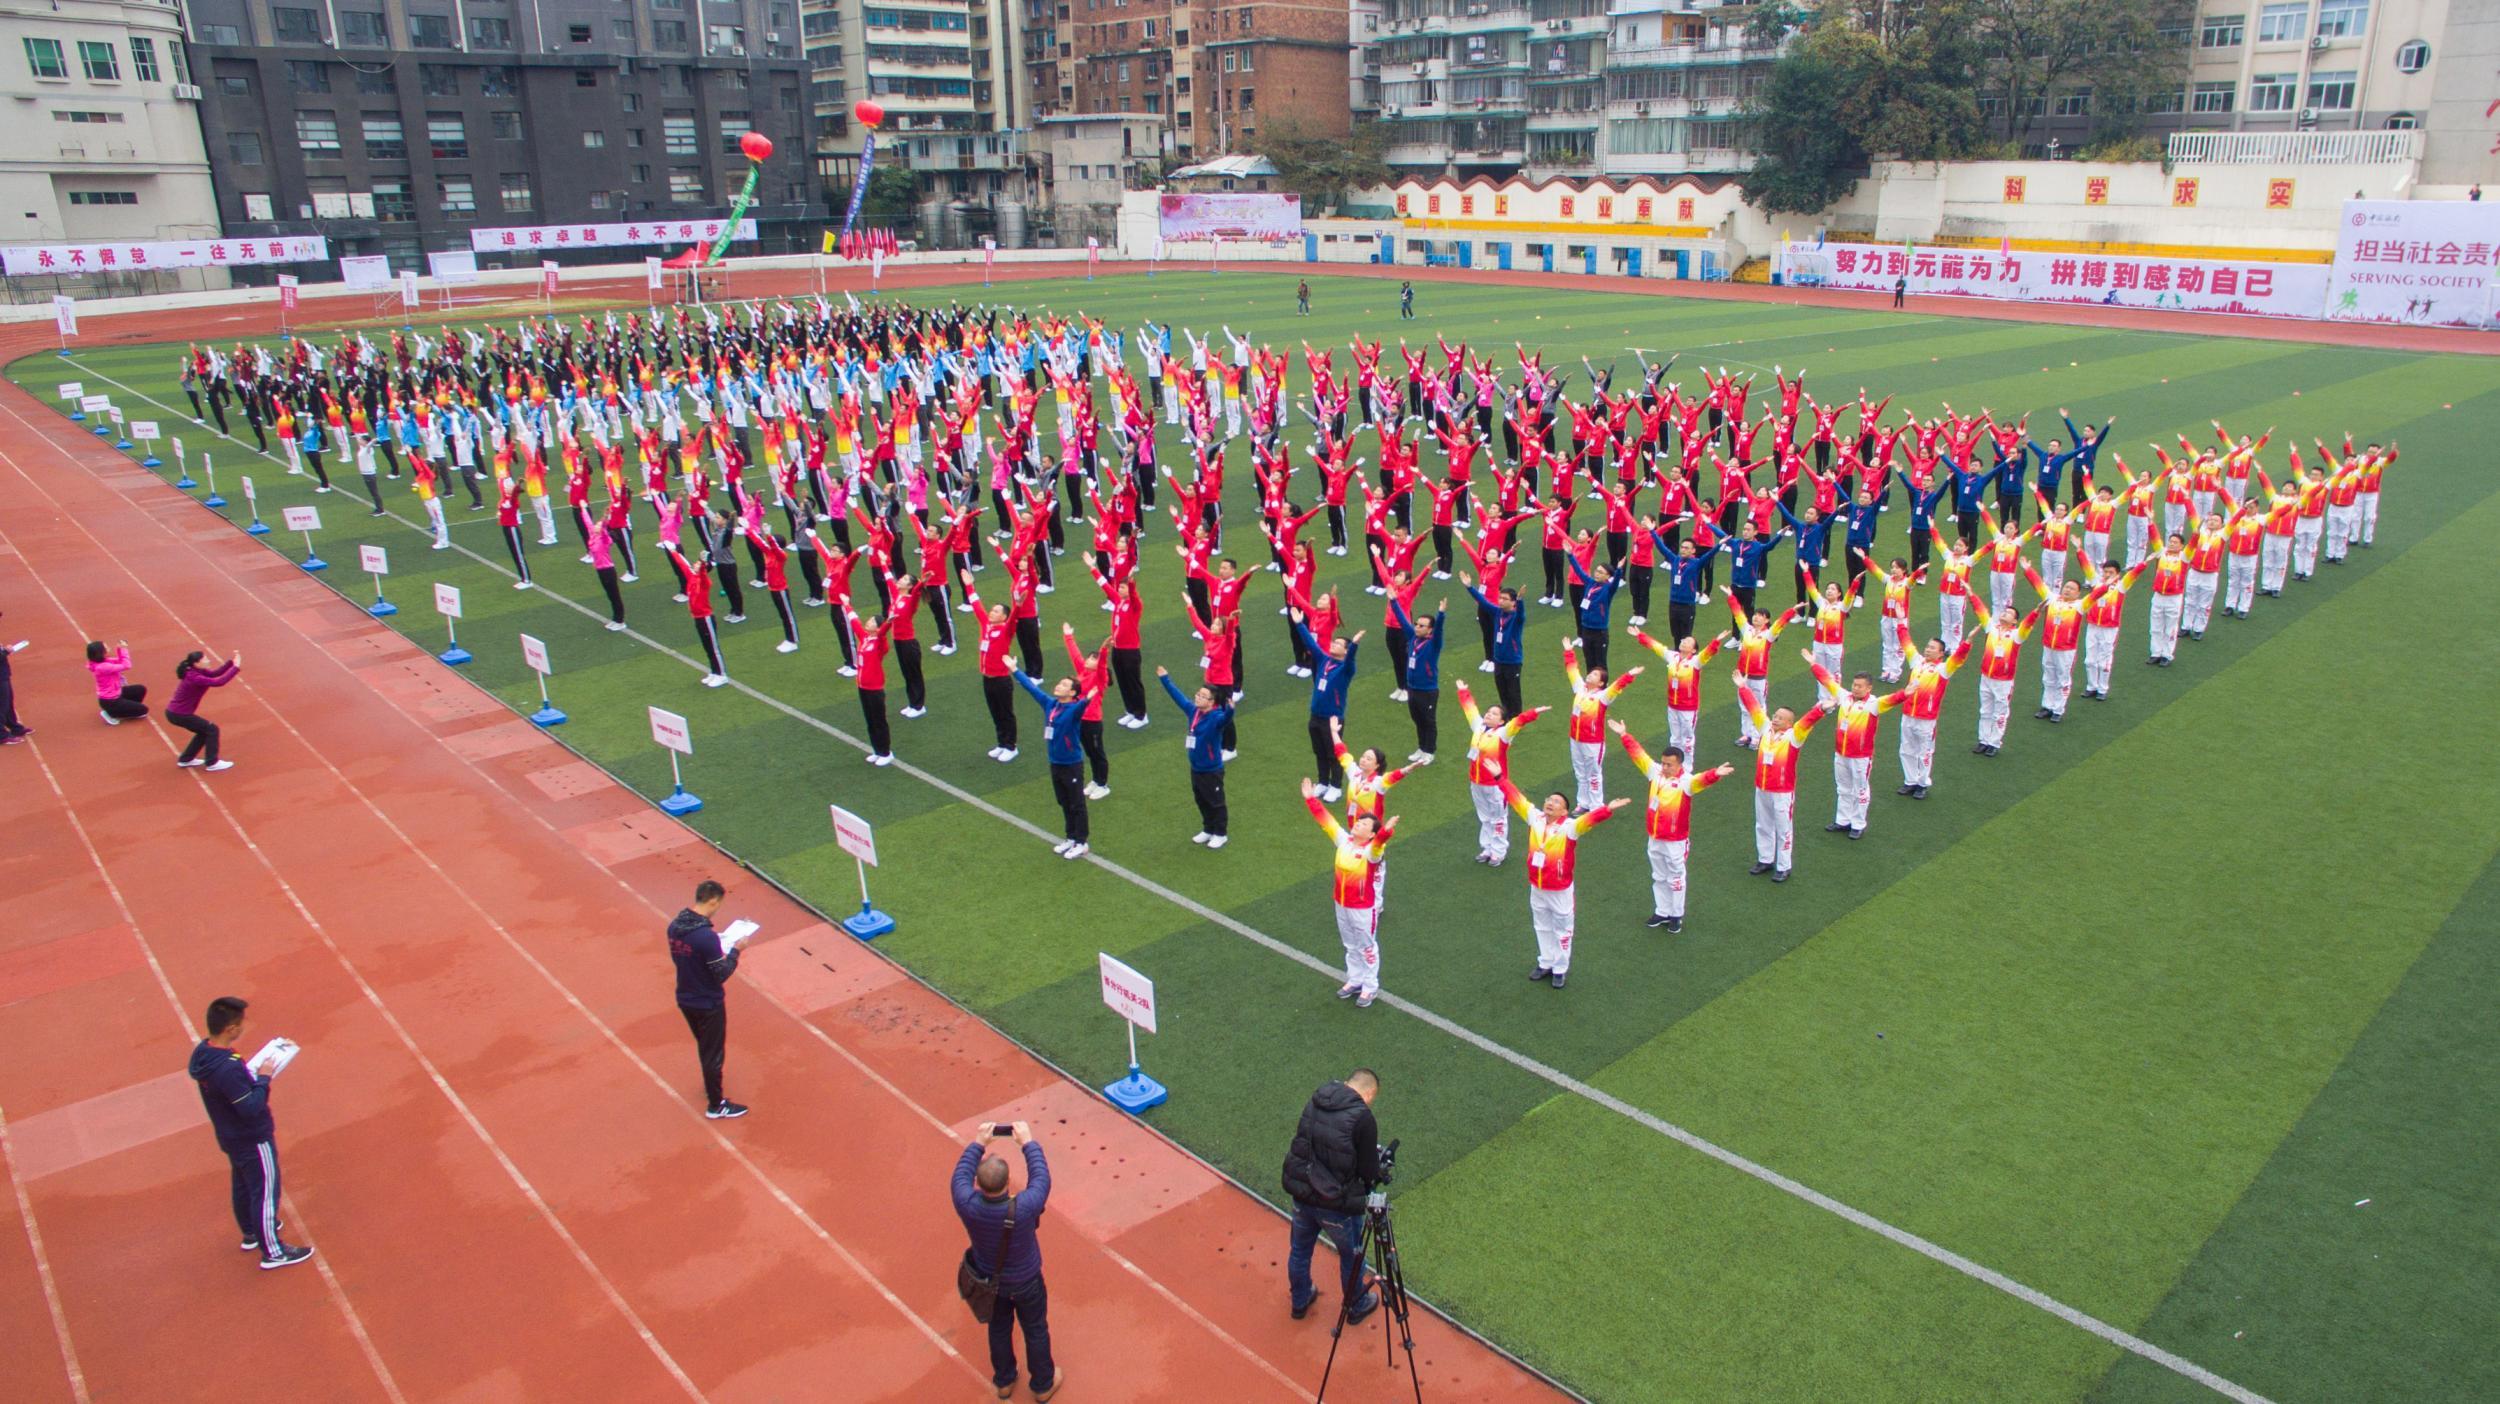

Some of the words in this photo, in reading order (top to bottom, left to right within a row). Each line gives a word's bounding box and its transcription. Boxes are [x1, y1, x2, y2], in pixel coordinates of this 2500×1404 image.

[2005, 177, 2292, 207] 科学求实
[1396, 194, 1507, 215] 祖国至上
[1560, 197, 1694, 219] 敬业奉献
[501, 225, 597, 246] 追求卓越
[627, 224, 718, 242] 永不停步
[38, 247, 146, 268] 永不懈怠
[179, 241, 285, 260] 一往无前
[2051, 259, 2273, 297] 拼搏到感动自己
[2350, 272, 2414, 286] SERVING
[2420, 274, 2486, 288] SOCIETY
